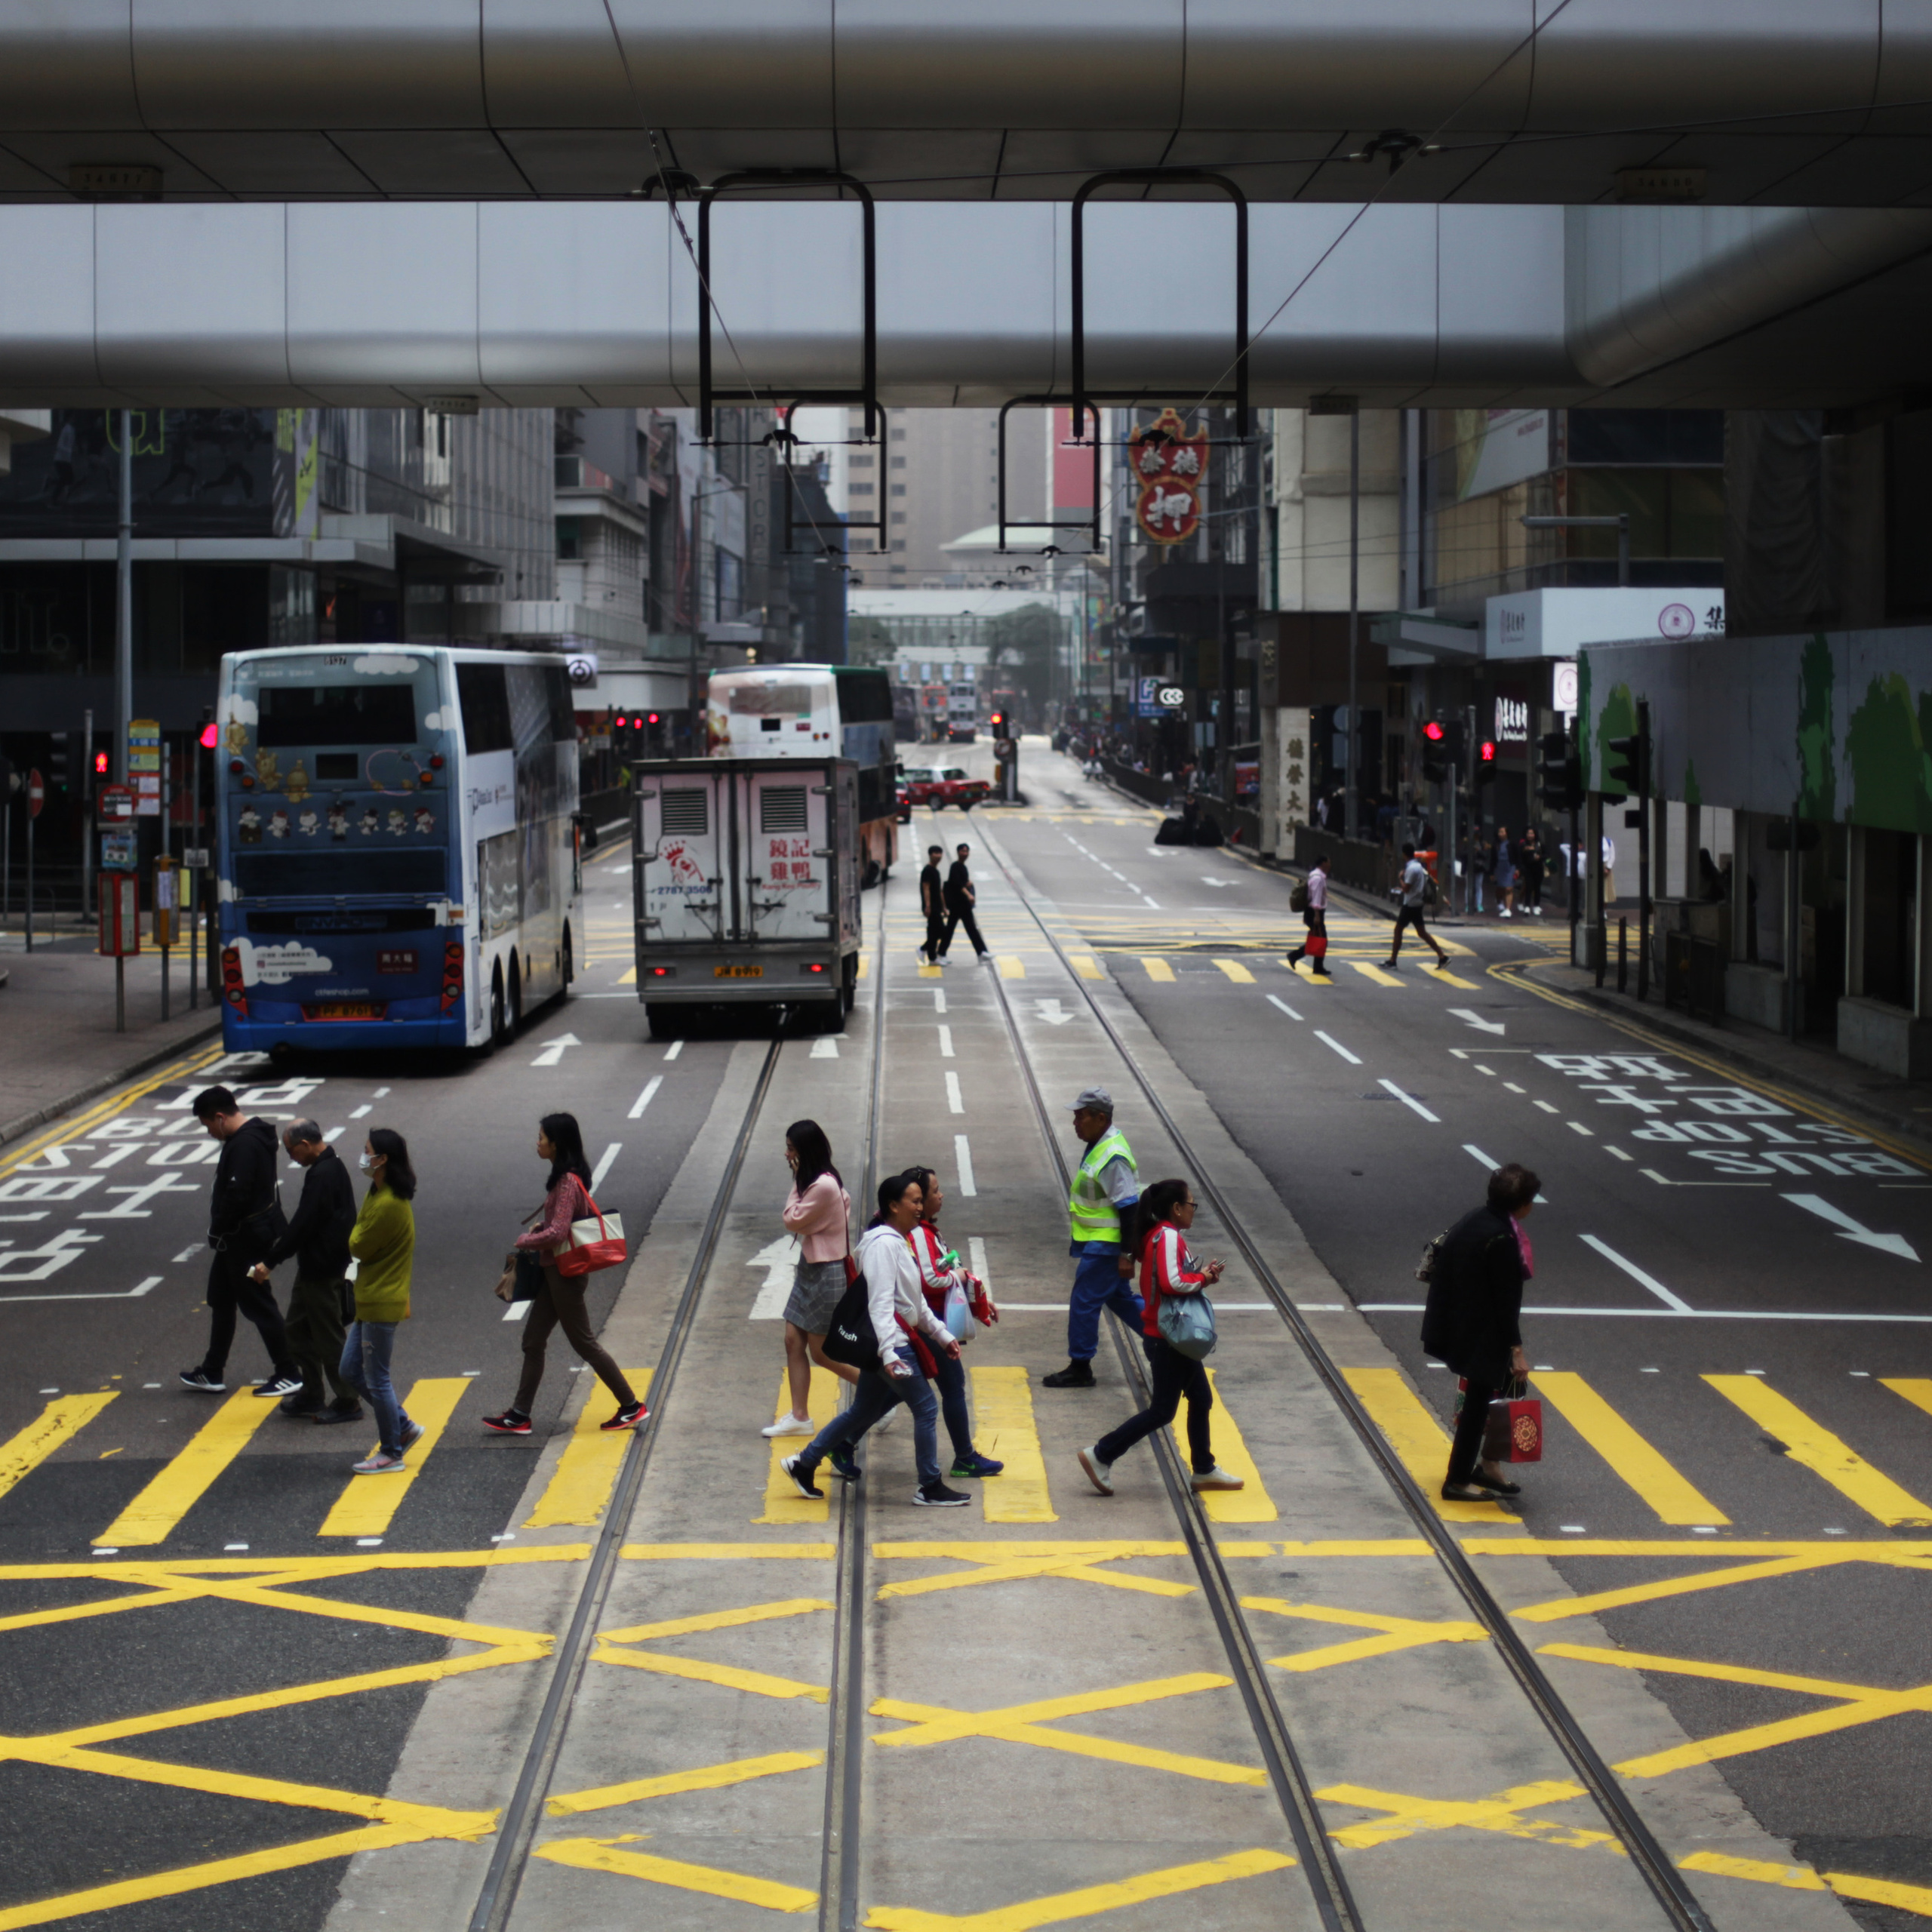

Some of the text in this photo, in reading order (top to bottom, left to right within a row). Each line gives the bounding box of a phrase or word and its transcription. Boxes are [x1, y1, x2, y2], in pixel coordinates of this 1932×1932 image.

[1146, 485, 1192, 533] 押
[1704, 606, 1725, 630] 集
[1631, 1121, 1875, 1144] STOP
[14, 1140, 226, 1171] STO
[1687, 1150, 1929, 1176] BUS
